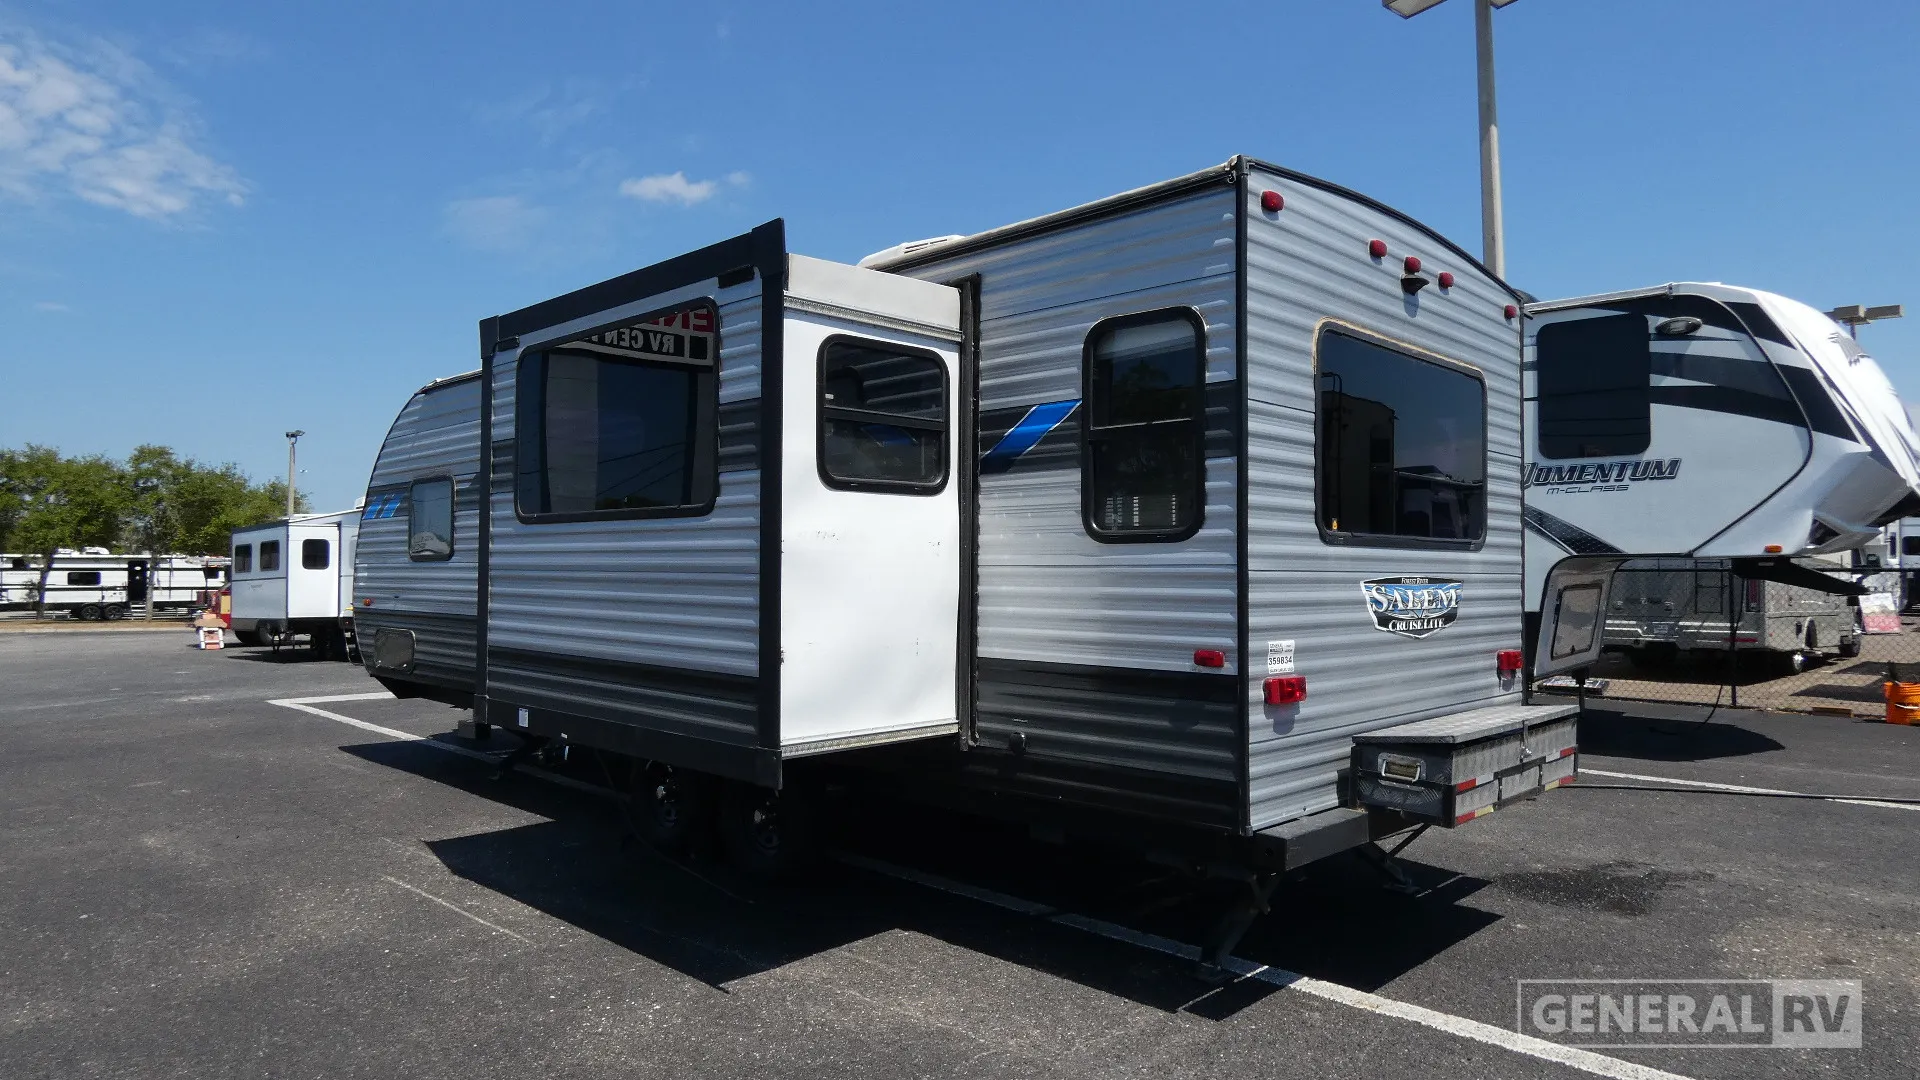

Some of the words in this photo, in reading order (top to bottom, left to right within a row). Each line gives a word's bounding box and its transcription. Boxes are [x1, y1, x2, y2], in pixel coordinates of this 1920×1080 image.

[1546, 484, 1630, 495] M-CLASS
[1371, 585, 1459, 613] SALEM
[1268, 655, 1293, 666] 359834
